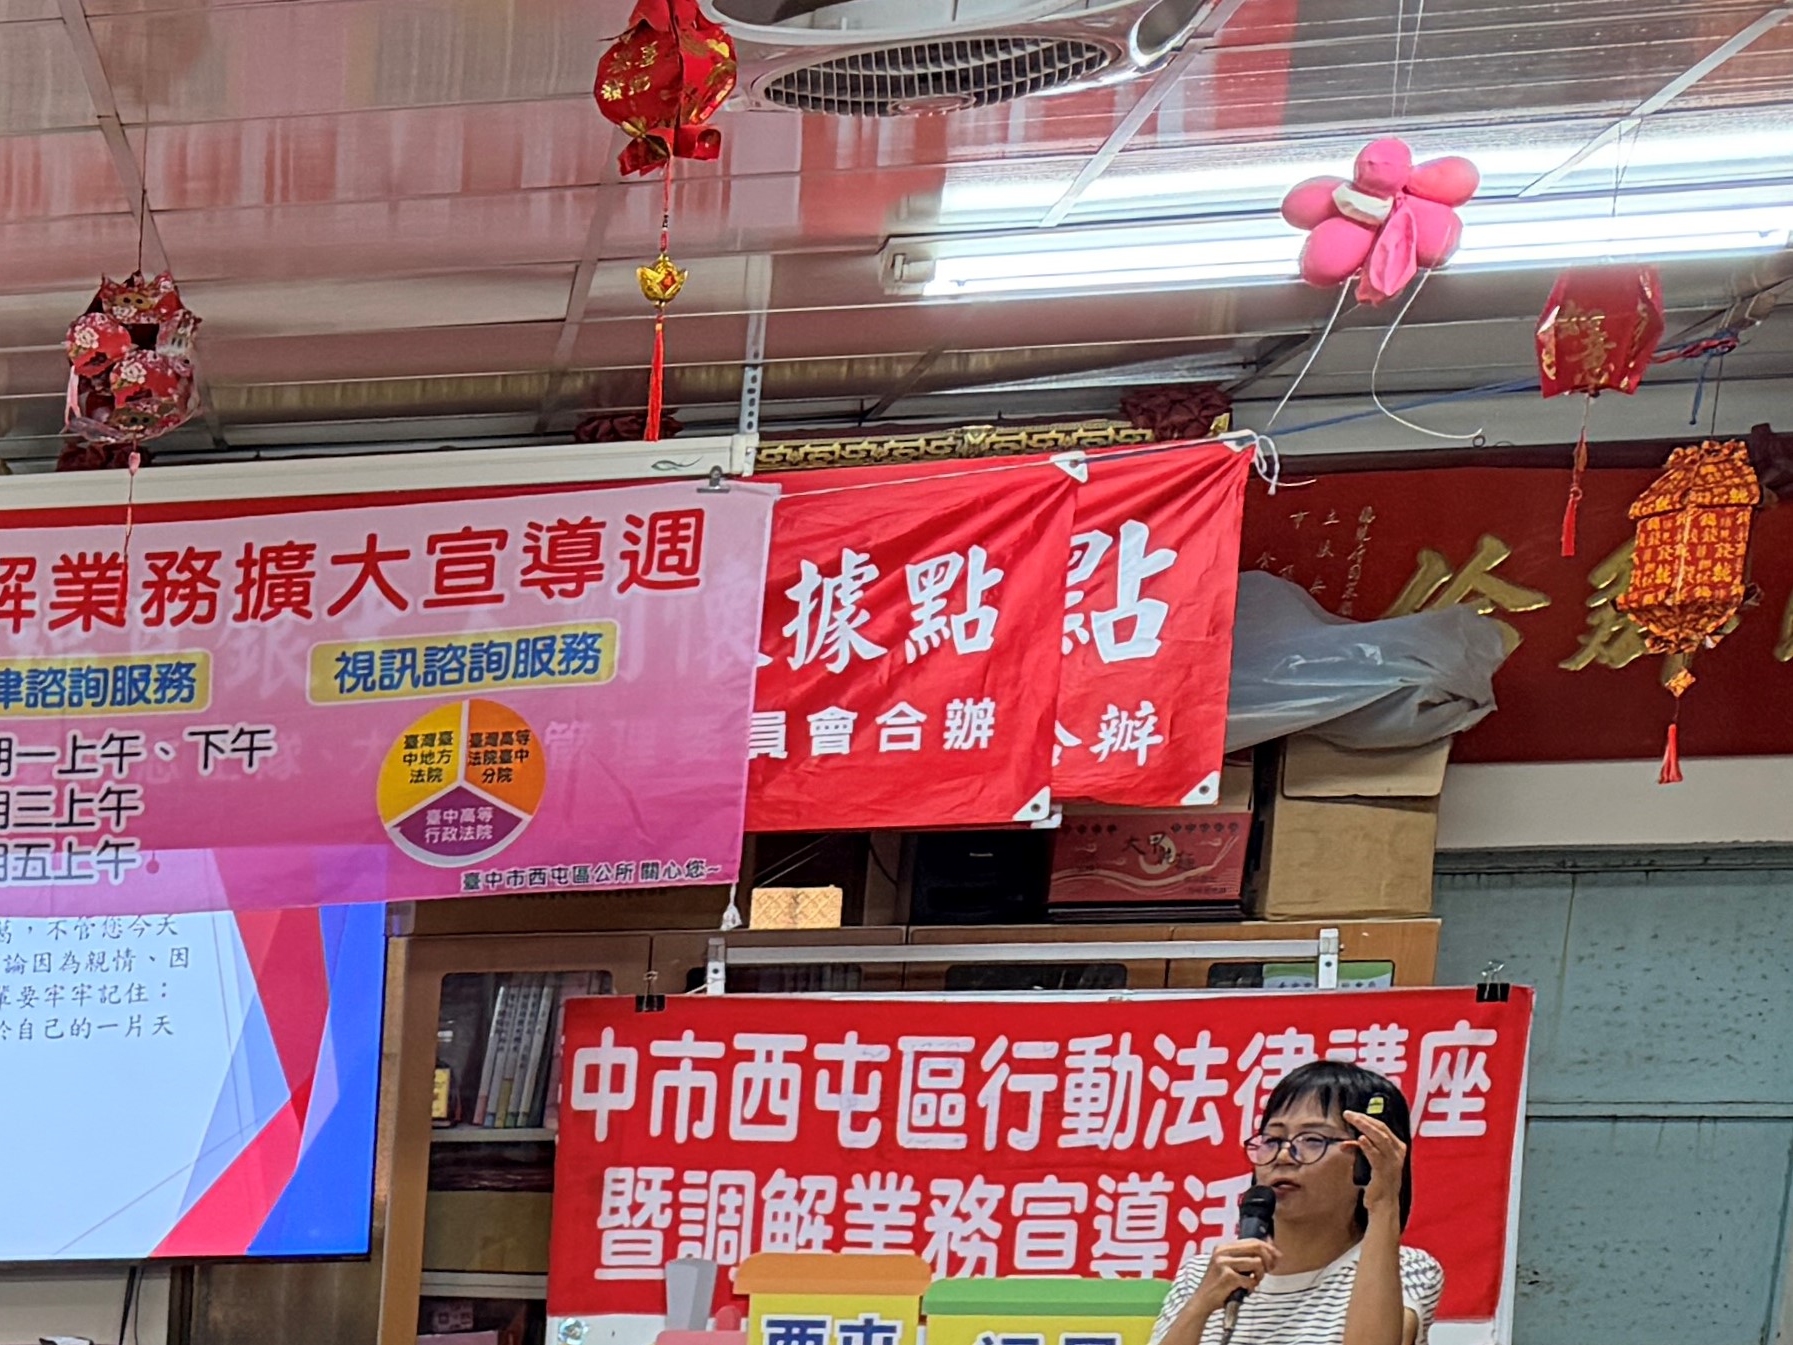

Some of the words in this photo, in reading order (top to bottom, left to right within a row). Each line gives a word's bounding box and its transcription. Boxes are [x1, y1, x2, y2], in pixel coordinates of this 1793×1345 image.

[332, 630, 603, 694] 視訊諮詢服務
[403, 730, 454, 749] 臺灣臺
[468, 729, 532, 749] 臺灣高等
[402, 748, 453, 766] 中地方
[467, 748, 530, 767] 法院臺中
[409, 767, 444, 785] 法院
[481, 767, 514, 785] 分院
[425, 806, 494, 825] 臺中高等
[424, 824, 494, 845] 行政法院
[462, 861, 635, 891] 臺中市西屯區公所
